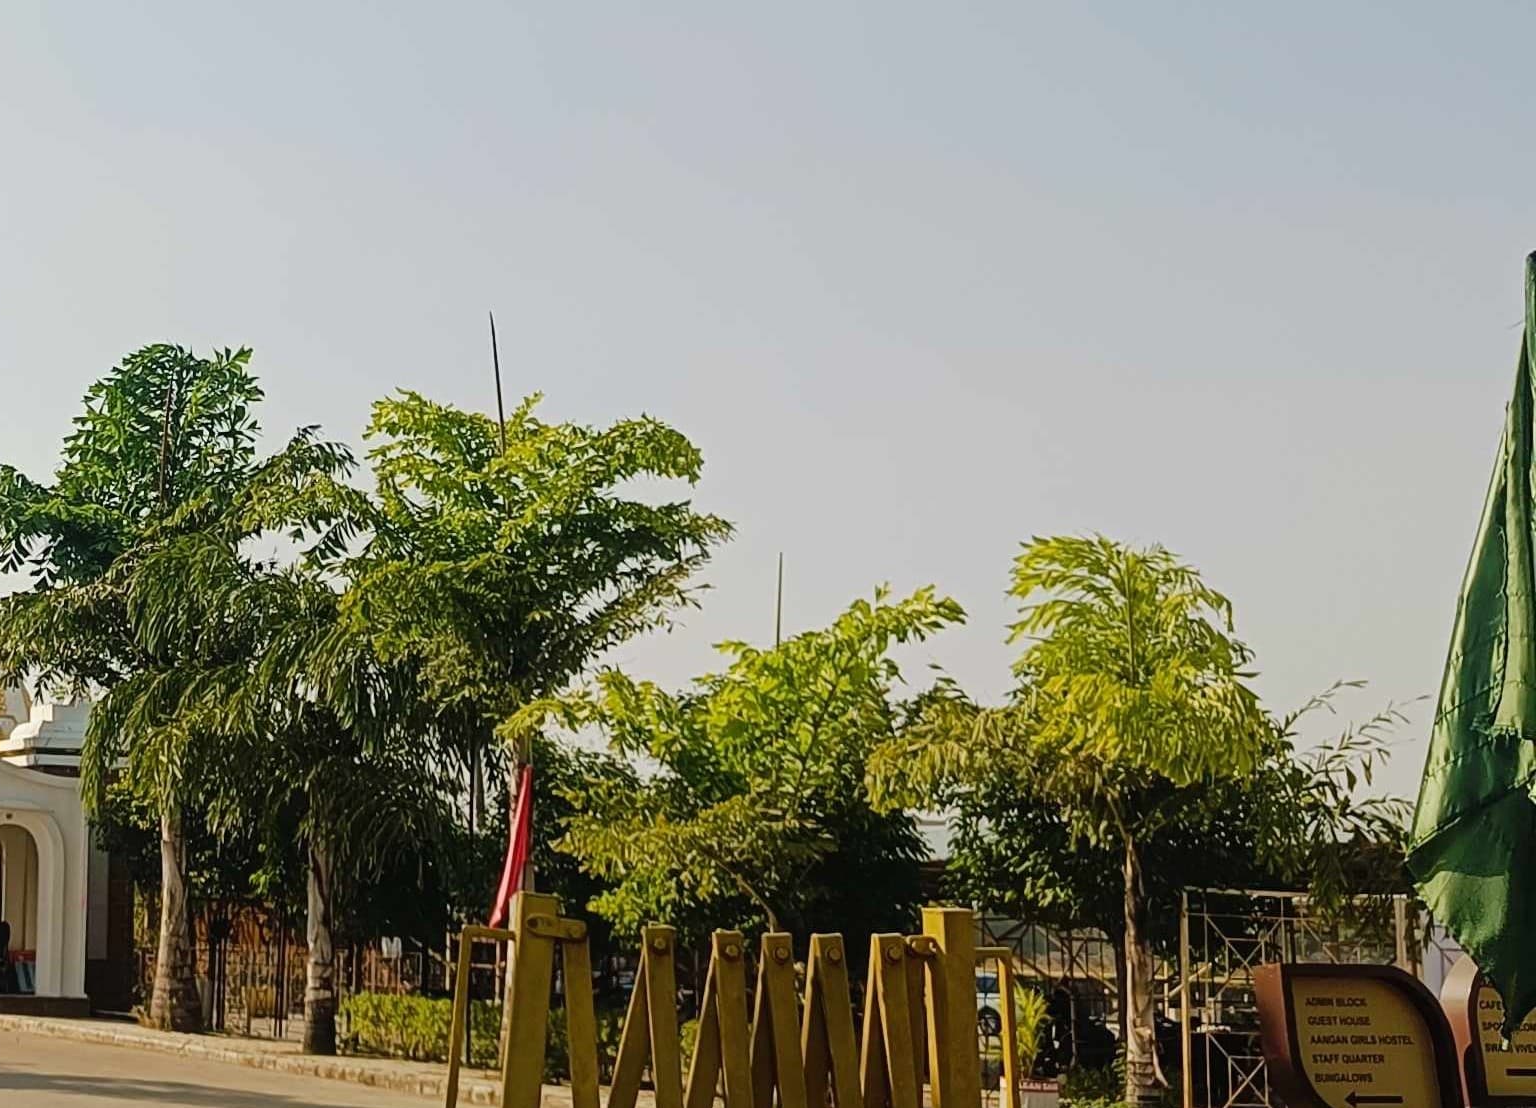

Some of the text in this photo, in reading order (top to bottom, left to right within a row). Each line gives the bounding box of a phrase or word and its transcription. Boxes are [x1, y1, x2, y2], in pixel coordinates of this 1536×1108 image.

[1336, 997, 1367, 1007] BLOCK
[1307, 1016, 1370, 1026] GUEST HOUSE
[1310, 1035, 1415, 1045] AANGAN GIRLS HOSTEL
[1312, 1054, 1385, 1064] STAFF QUARTER
[1314, 1073, 1373, 1083] BUNGALOWS
